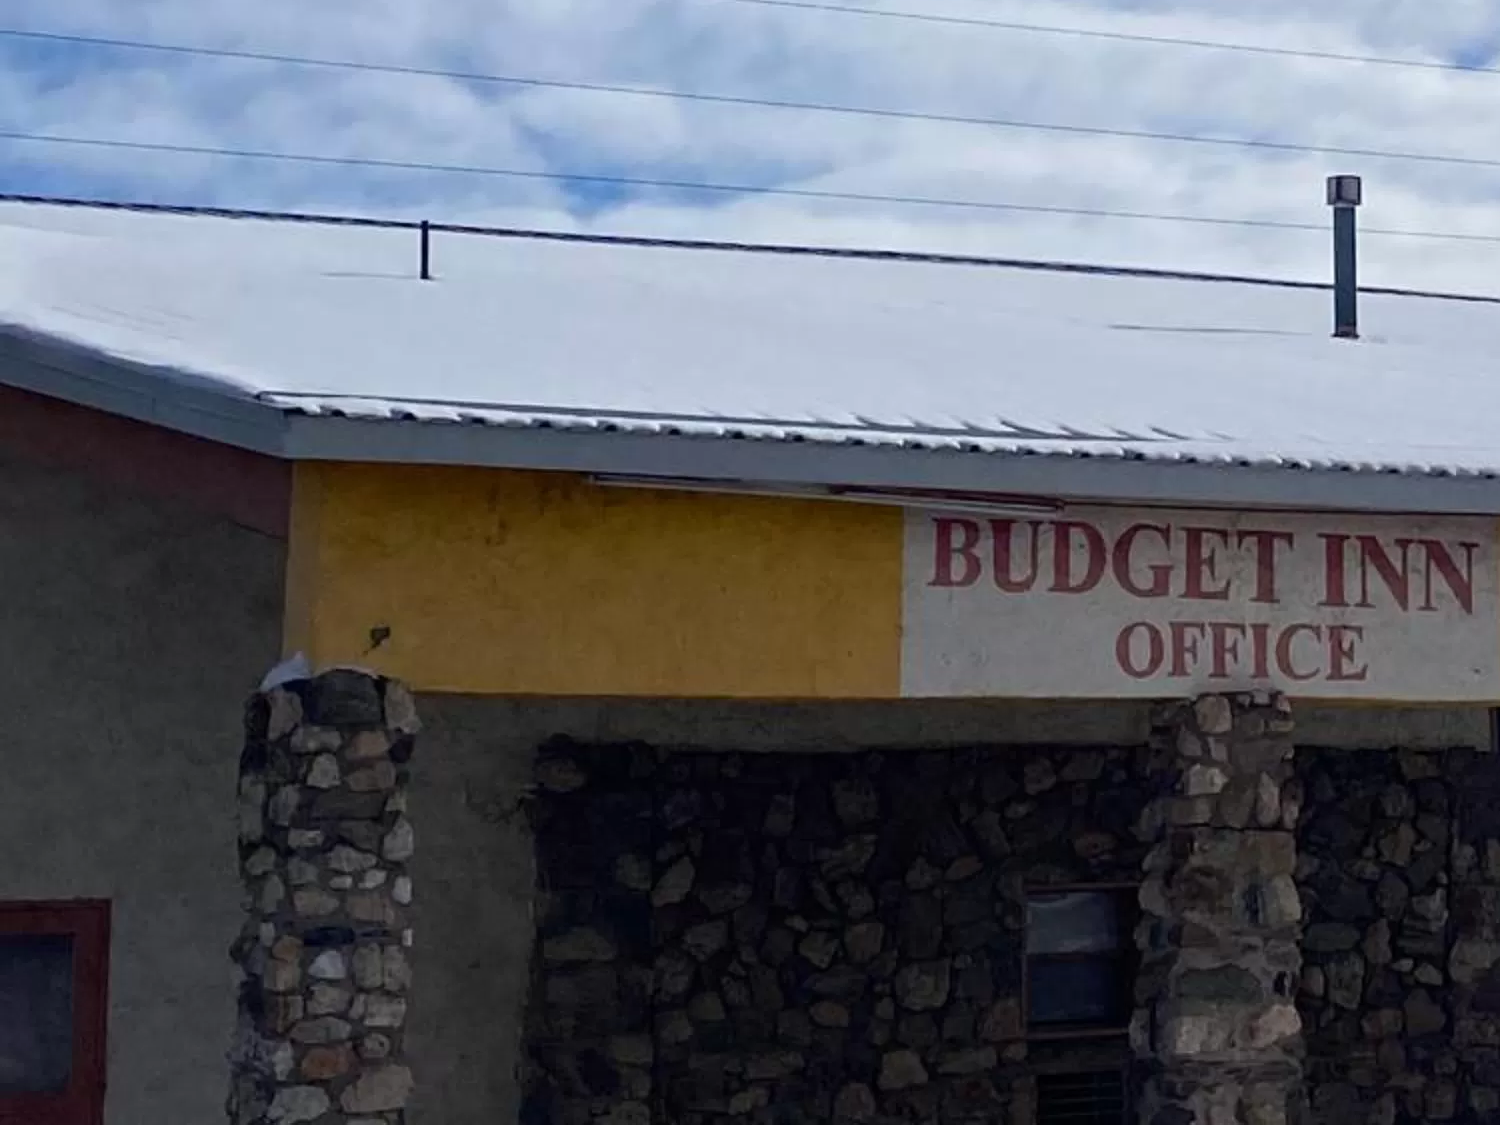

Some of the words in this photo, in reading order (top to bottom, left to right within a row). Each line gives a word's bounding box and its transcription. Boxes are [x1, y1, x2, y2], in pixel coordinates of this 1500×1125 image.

[926, 516, 1294, 605] BUDGET
[1316, 531, 1481, 616] INN
[1115, 620, 1369, 682] OFFICE
